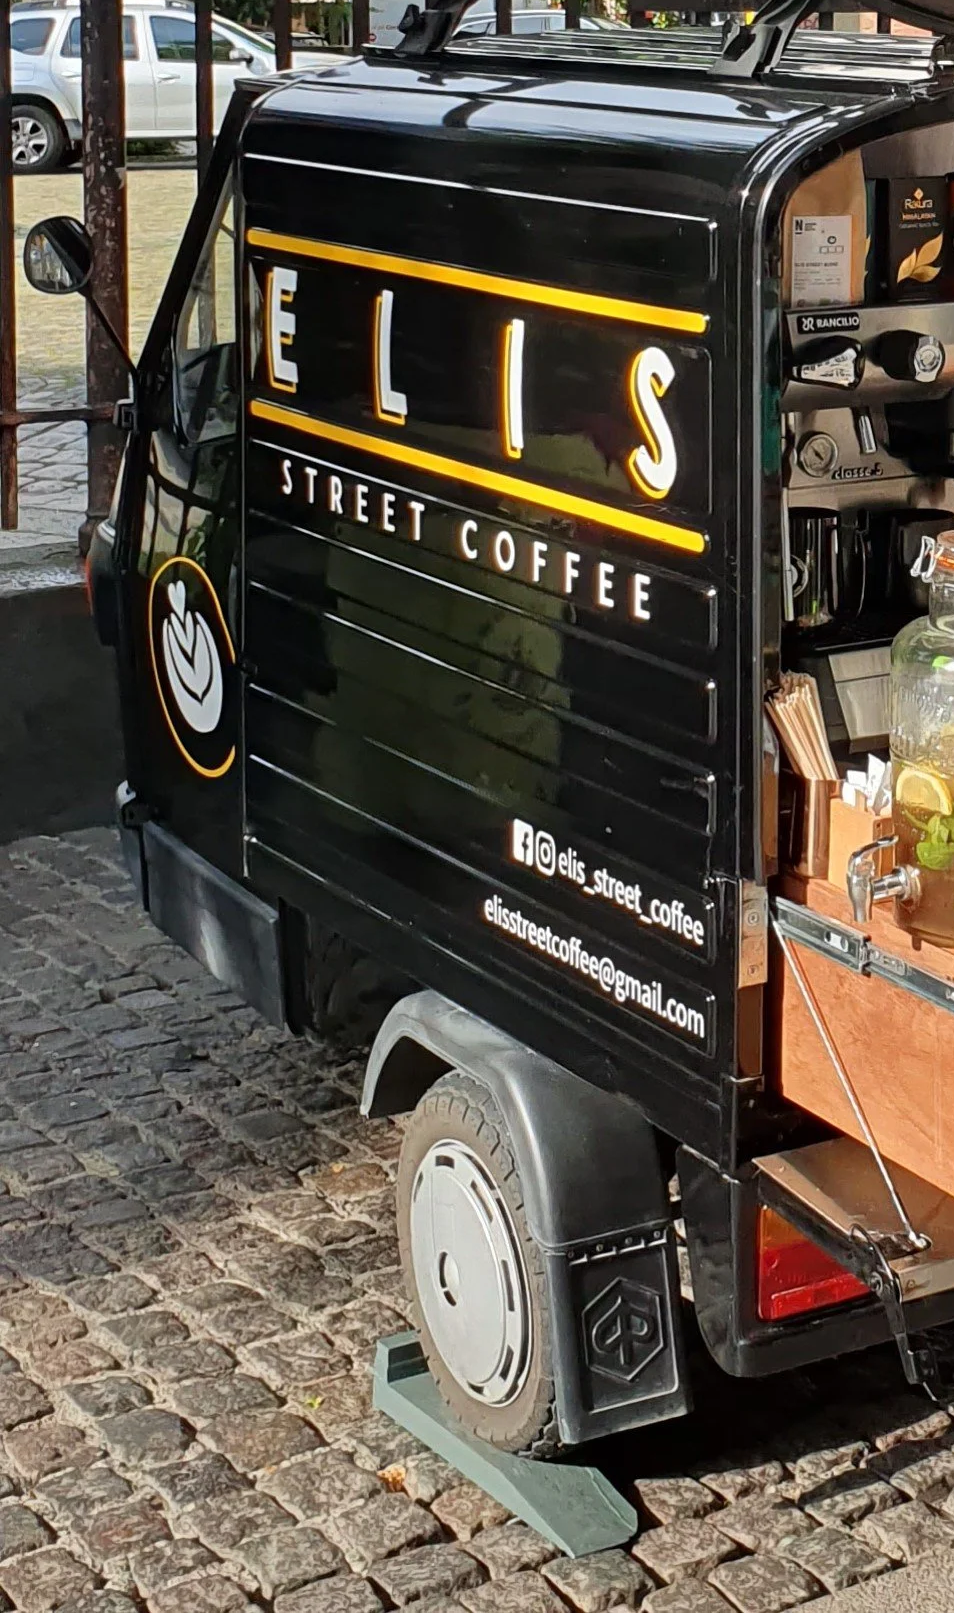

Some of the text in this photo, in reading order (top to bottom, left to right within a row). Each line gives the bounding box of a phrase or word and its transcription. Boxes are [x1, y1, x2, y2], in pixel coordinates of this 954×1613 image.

[268, 266, 678, 500] ELIS
[816, 316, 860, 328] RANCILIO
[281, 458, 651, 621] STREET COFFEE
[483, 894, 705, 1038] elisstreetcoffee@gmail.com
[558, 847, 704, 945] elis_street_coffee
